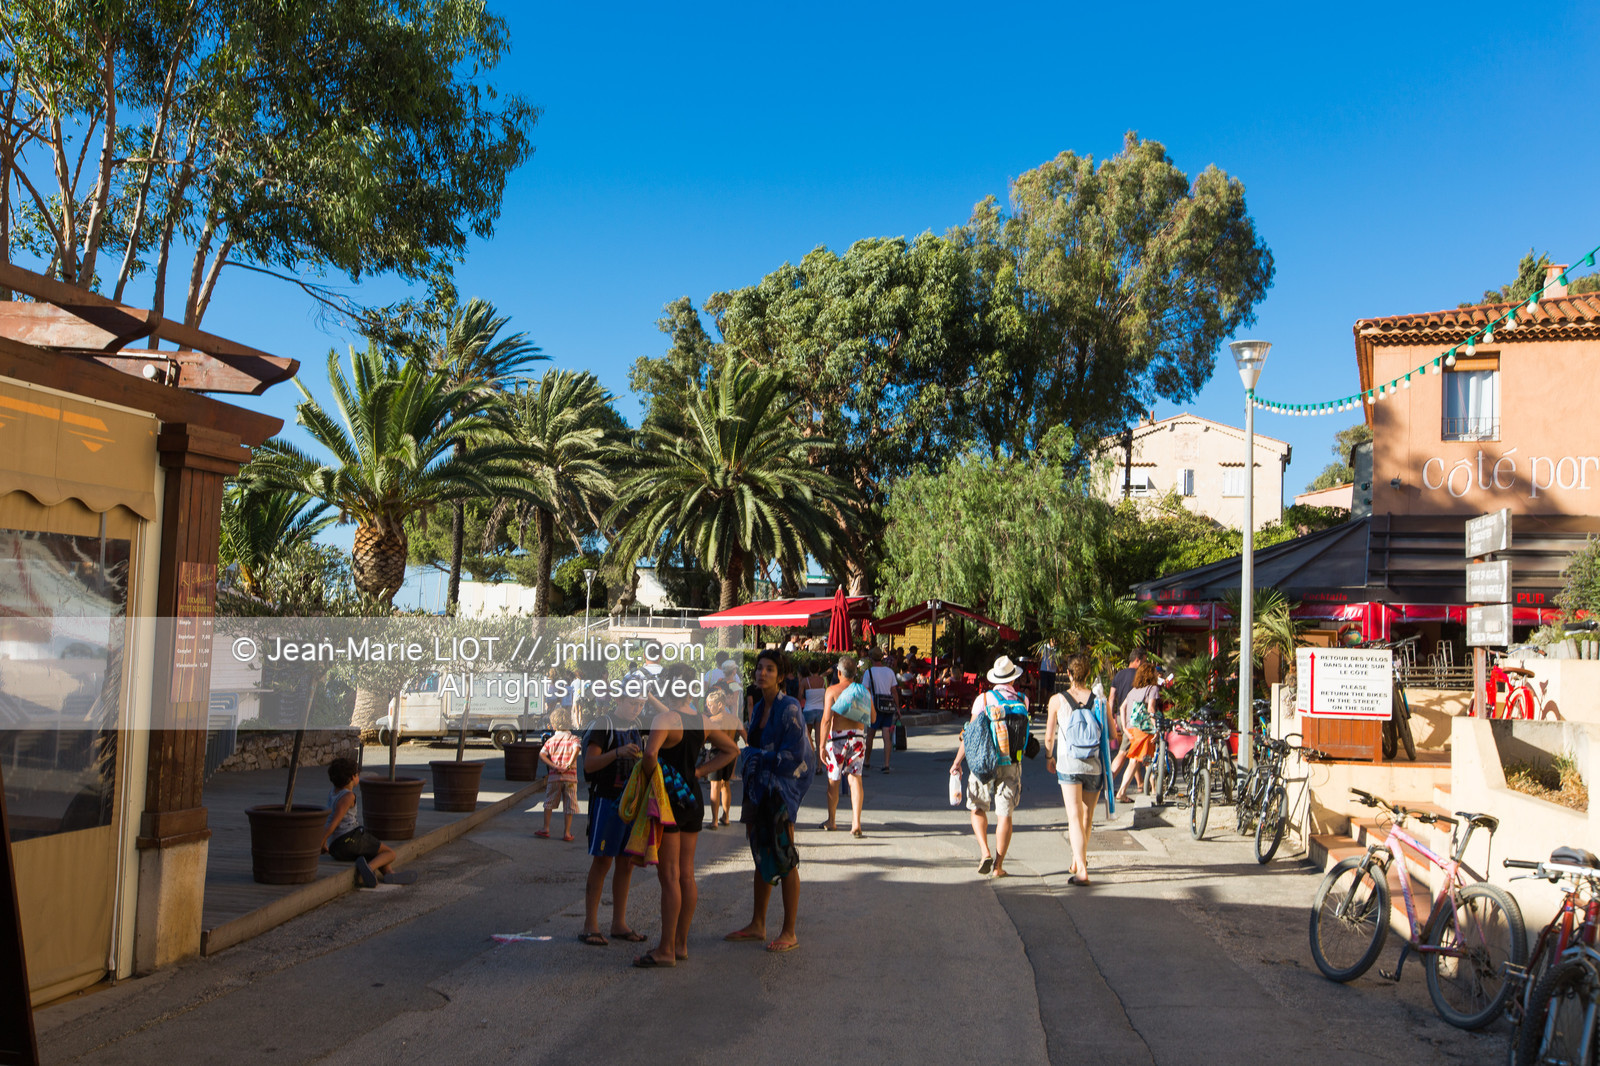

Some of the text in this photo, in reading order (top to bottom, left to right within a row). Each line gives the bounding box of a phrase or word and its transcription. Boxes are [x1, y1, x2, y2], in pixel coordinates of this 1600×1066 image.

[1422, 447, 1600, 499] côté por
[1303, 593, 1348, 601] Cocktails
[1517, 592, 1545, 604] PUB
